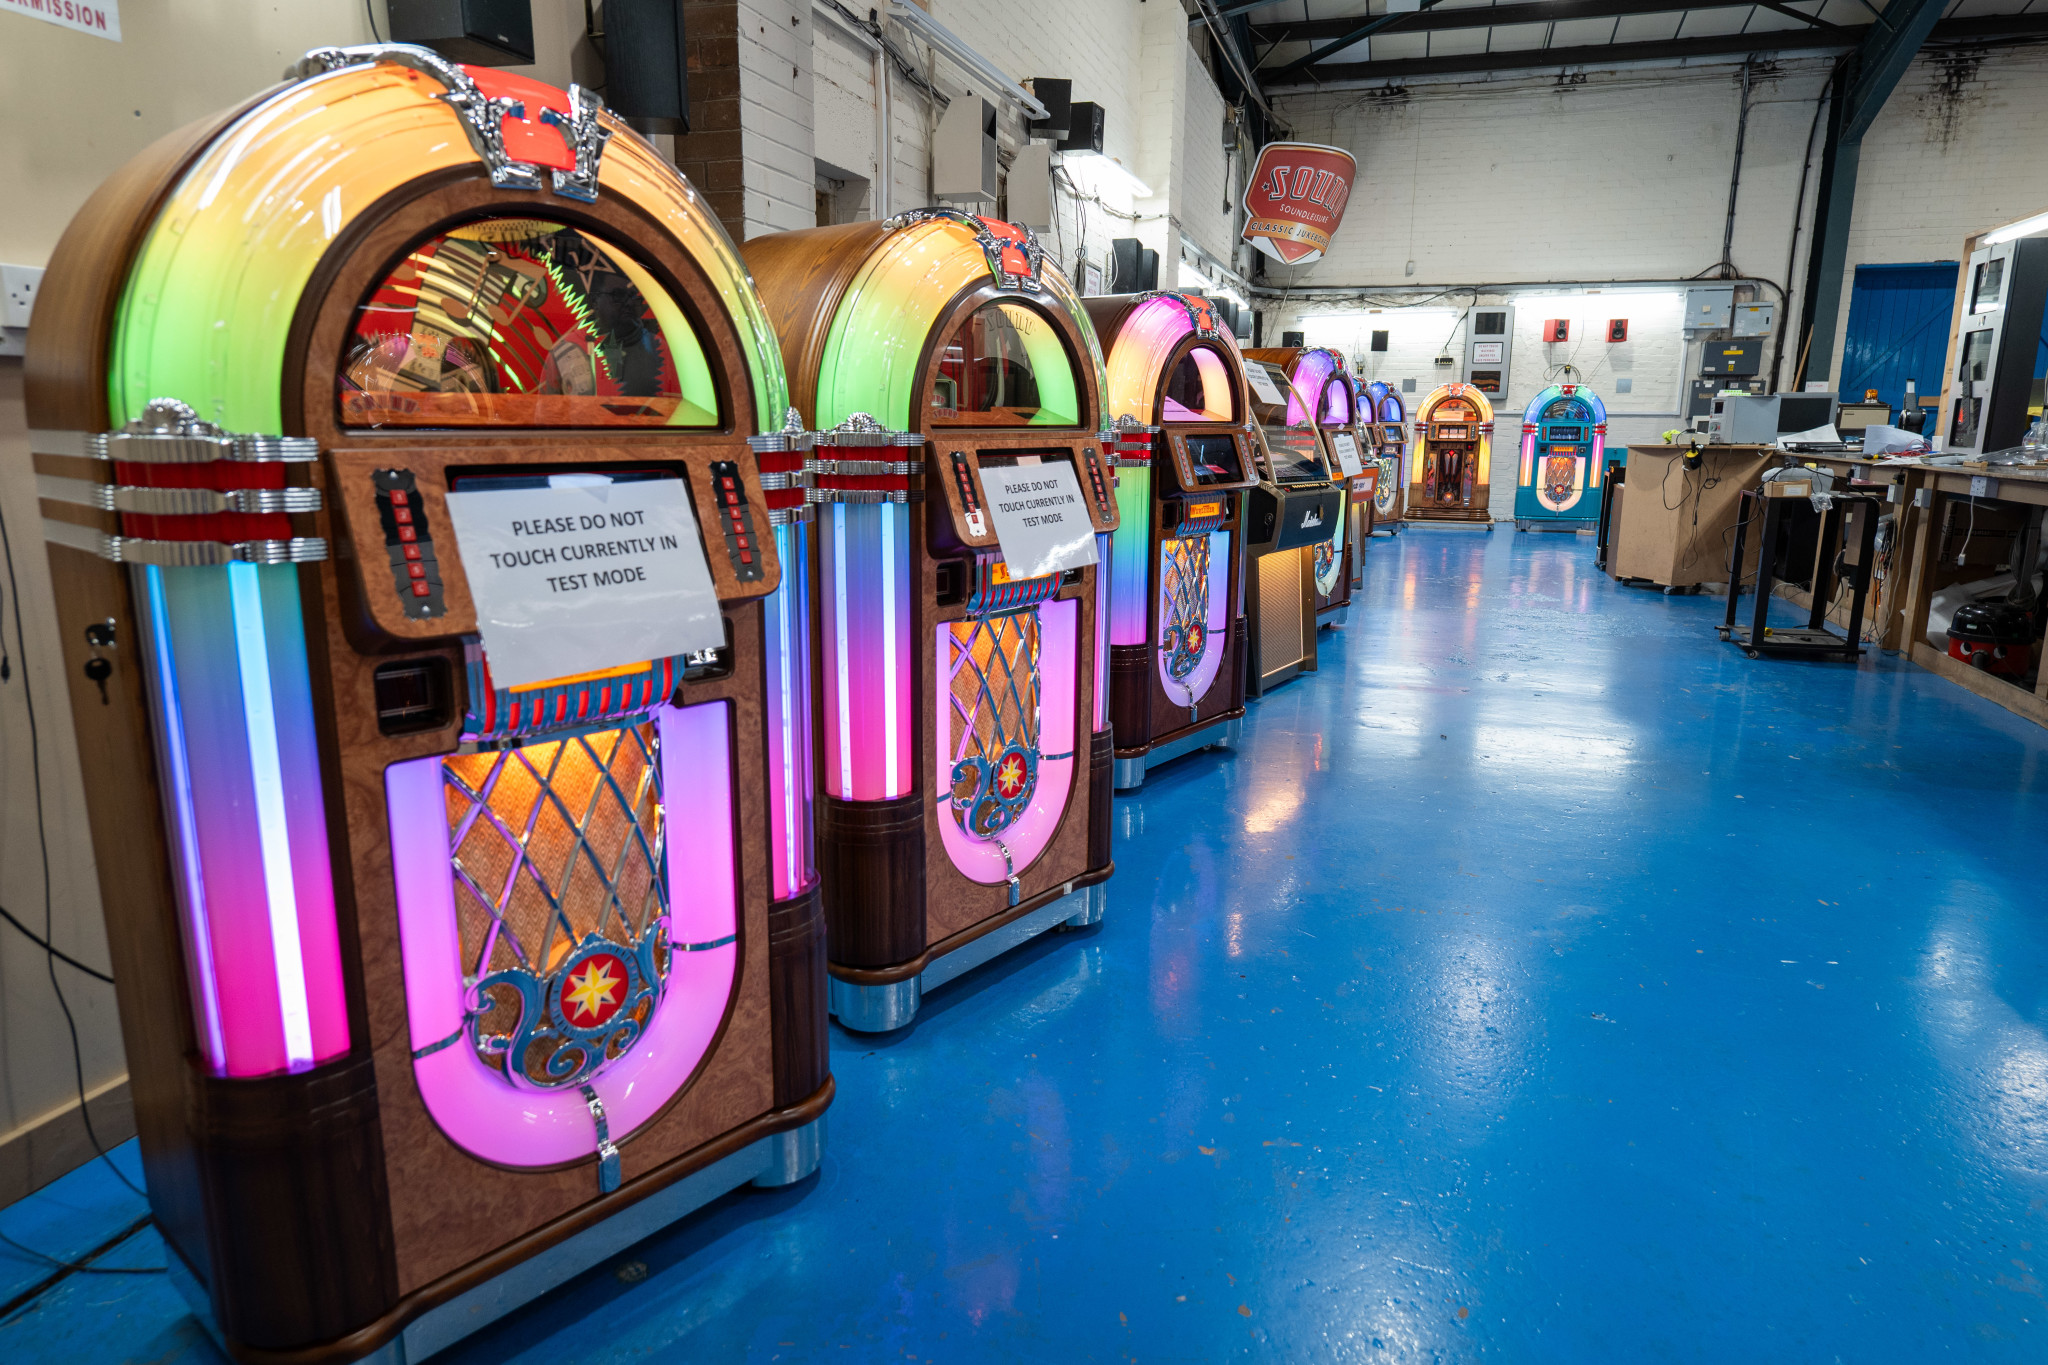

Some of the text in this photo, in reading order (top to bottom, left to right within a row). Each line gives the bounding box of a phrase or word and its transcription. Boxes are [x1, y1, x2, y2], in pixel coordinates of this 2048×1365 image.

[6, 0, 107, 31] MISSION
[1280, 204, 1329, 224] SOUNDLEISURE
[1251, 222, 1294, 235] CLASSIC
[1005, 479, 1059, 495] PLEASE DO NOT
[999, 494, 1075, 513] TOUCH CURRENTLY IN
[512, 510, 645, 536] PLEASE DO NOT
[1022, 512, 1064, 528] TEST MODE
[490, 534, 679, 569] TOUCH CURRENTLY IN
[546, 566, 647, 593] TEST MODE
